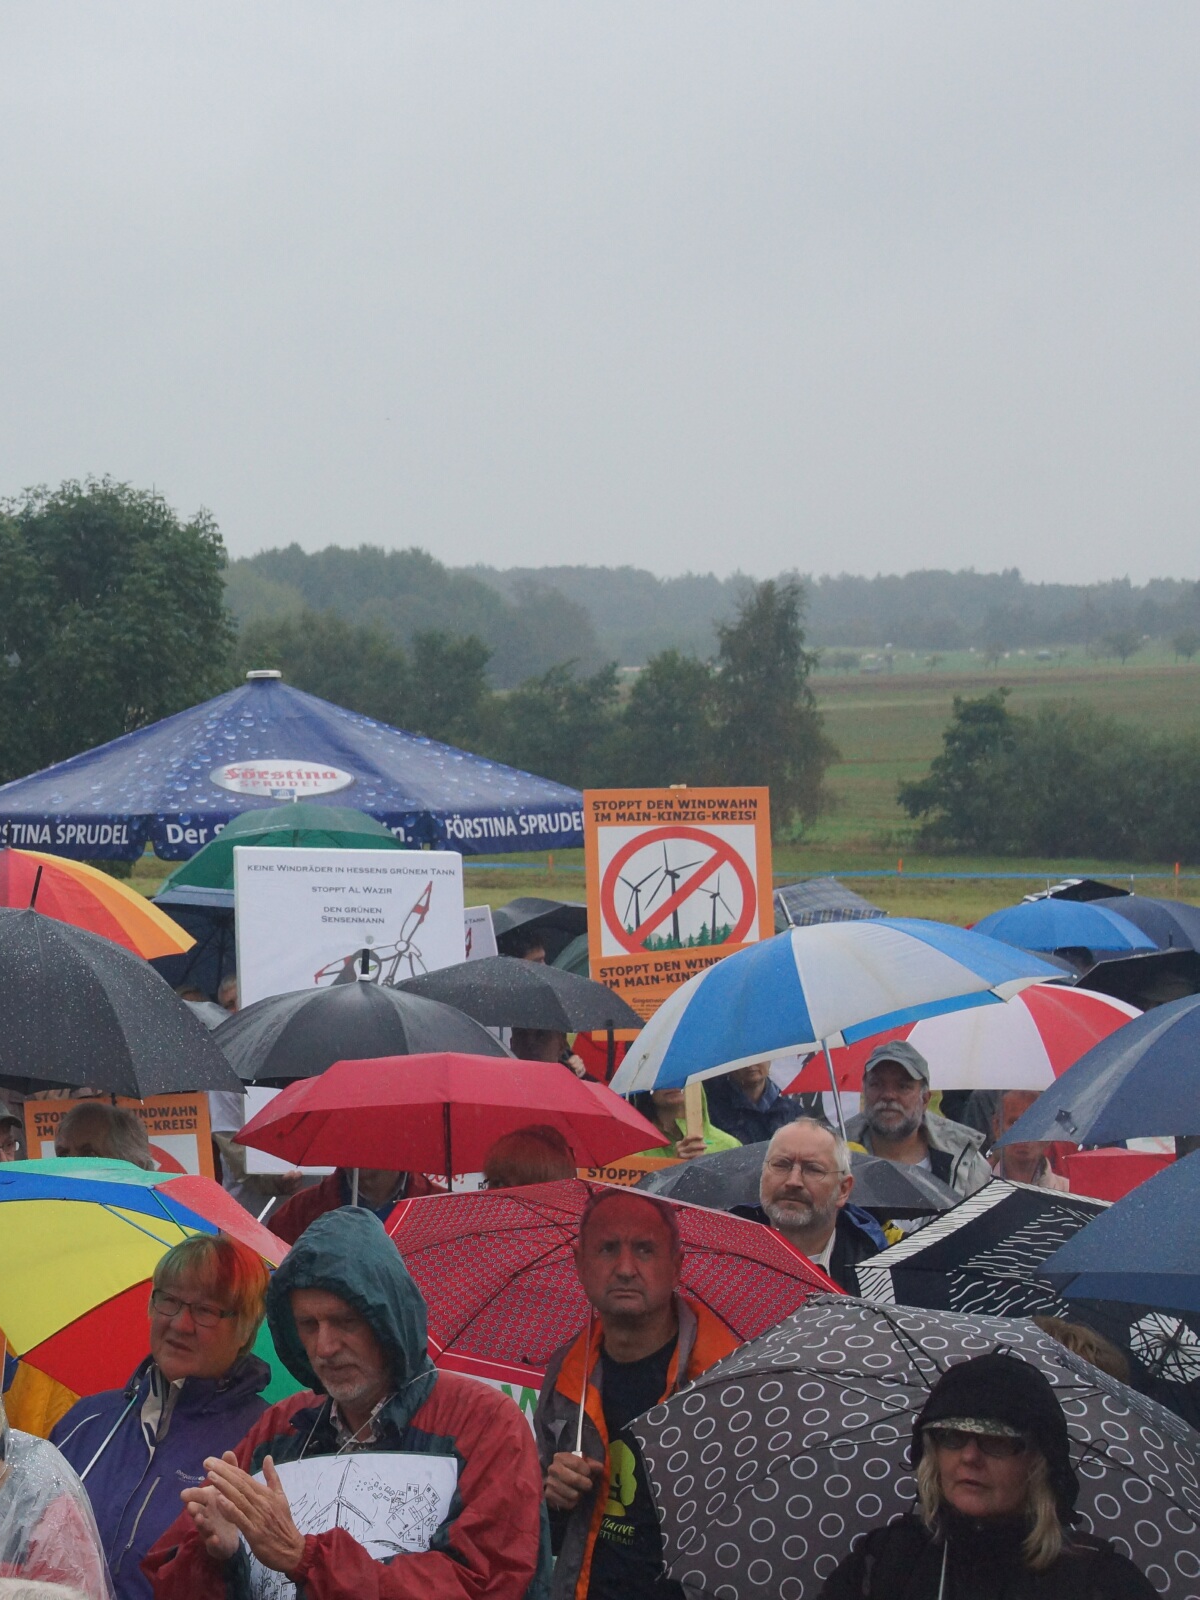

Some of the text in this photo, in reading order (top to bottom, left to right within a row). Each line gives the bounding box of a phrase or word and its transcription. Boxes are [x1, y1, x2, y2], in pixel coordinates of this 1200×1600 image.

[240, 780, 323, 788] SPRUDEL
[592, 799, 759, 811] STOPPT DEN WINDWAHN
[594, 810, 757, 823] IM MAIN-KINZIG-KREIS!
[444, 813, 519, 840] FÖRSTINA
[55, 824, 130, 845] SPRUDEL
[166, 823, 209, 845] Der
[246, 864, 275, 872] KEINE
[346, 866, 388, 875] HESSENS
[389, 867, 428, 876] GRÜNEM
[311, 886, 346, 894] STOPPT
[344, 906, 382, 914] GRÜNEN
[599, 963, 651, 978] STOPPT
[653, 959, 682, 973] DEN
[37, 1125, 54, 1137] IM
